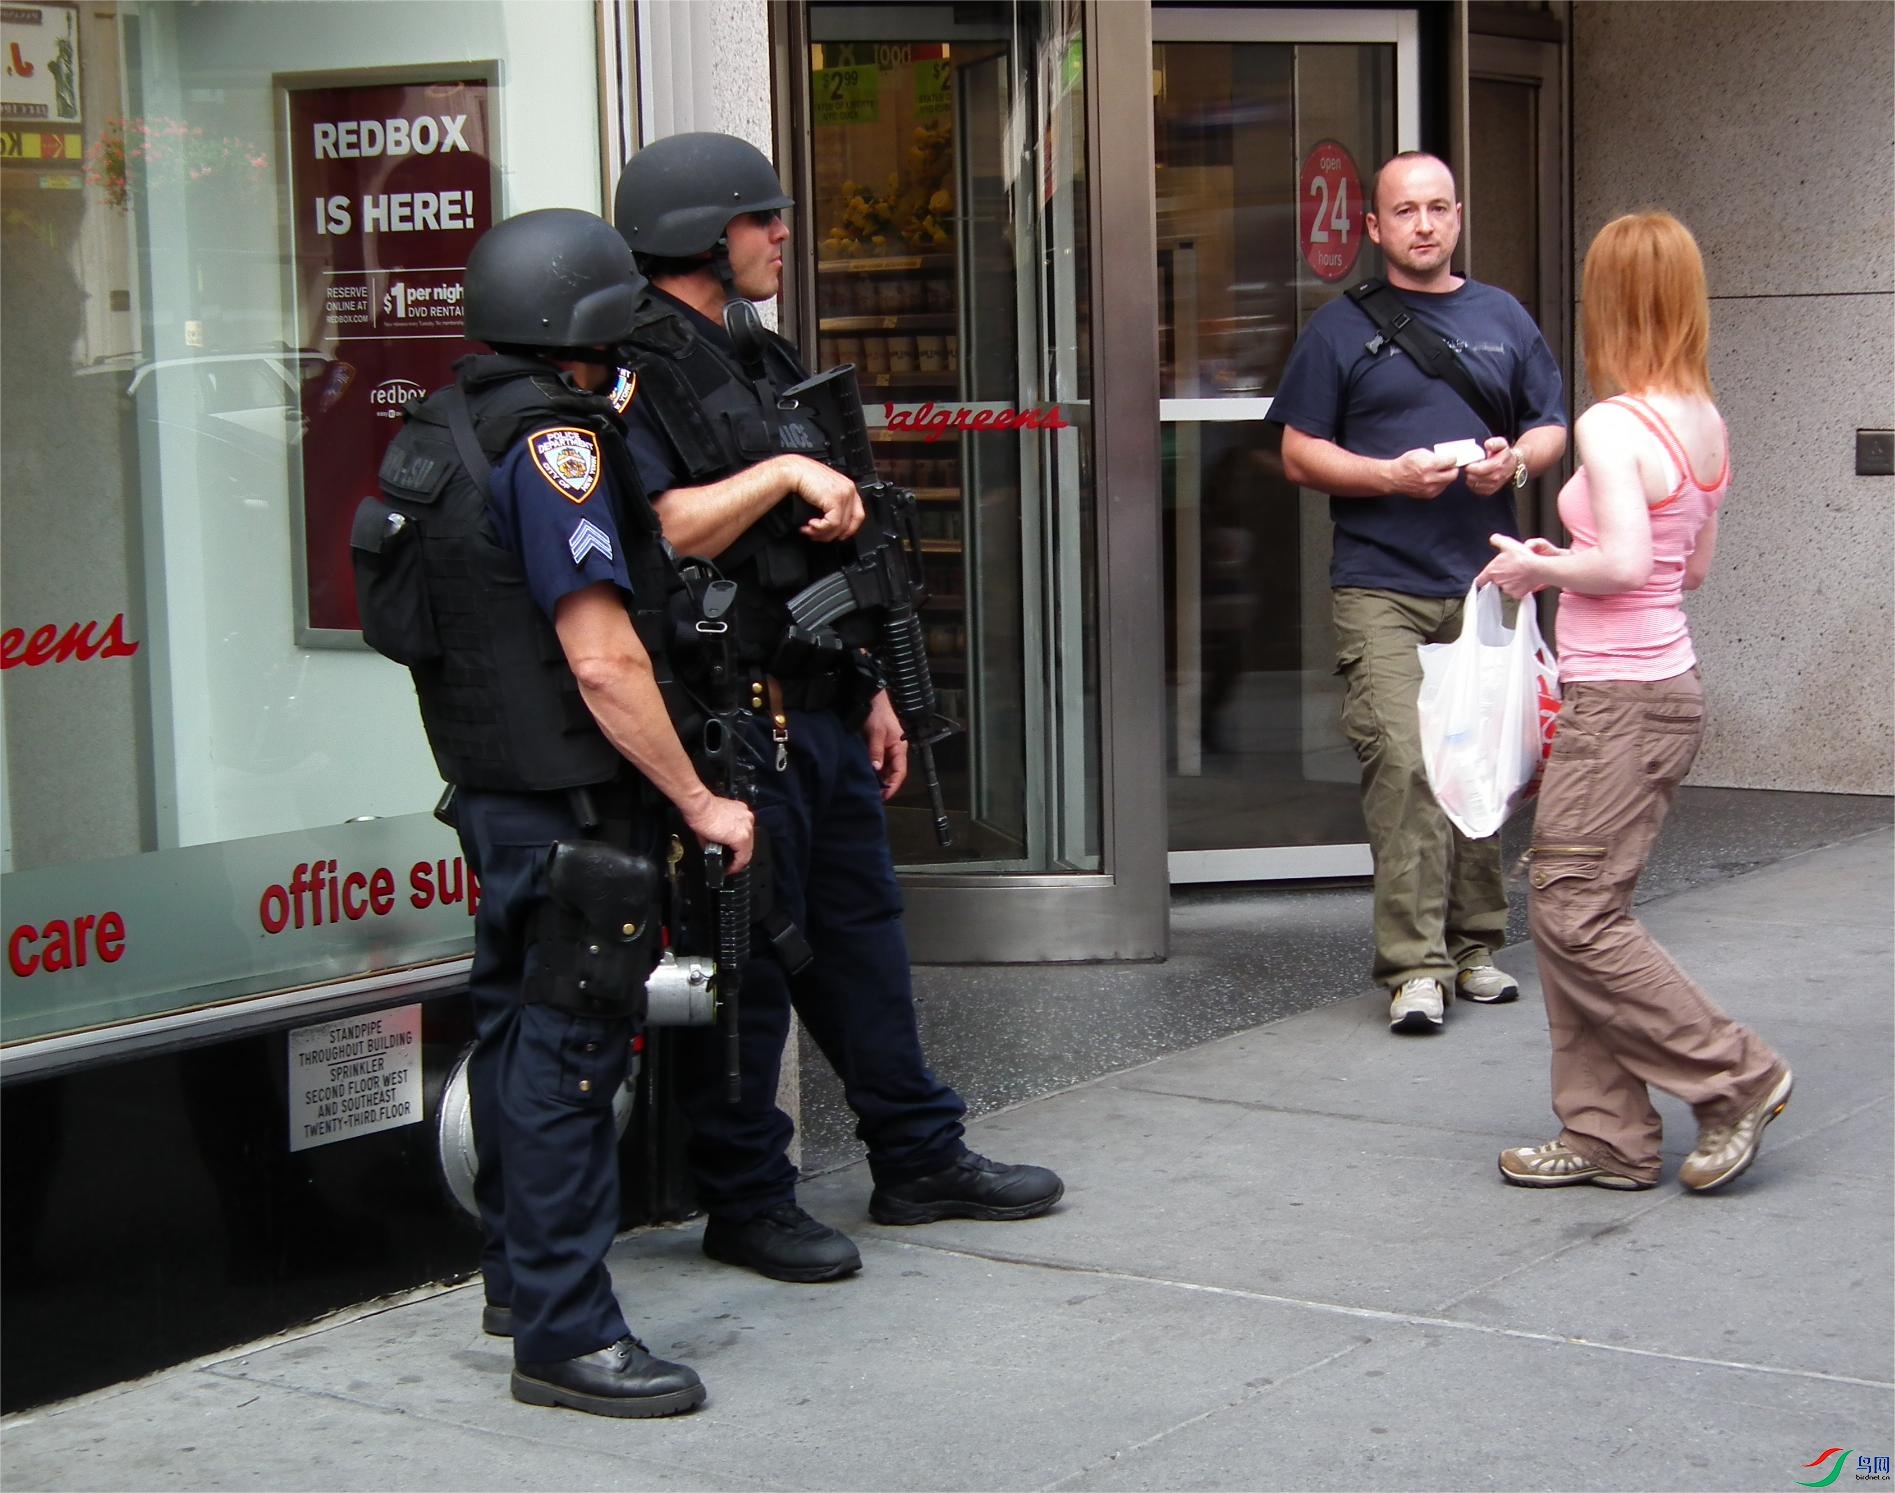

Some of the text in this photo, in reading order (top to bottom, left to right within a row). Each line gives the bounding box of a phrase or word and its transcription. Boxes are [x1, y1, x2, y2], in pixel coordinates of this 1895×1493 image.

[313, 115, 471, 160] REDBOX
[1320, 157, 1342, 173] open
[315, 190, 474, 235] IS HERE!
[1310, 175, 1350, 244] 24
[1318, 251, 1342, 266] hours
[326, 286, 368, 298] RESERVE
[326, 301, 368, 312] ONLINE AT
[383, 282, 464, 318] $1 per nigh
[326, 314, 369, 324] REDBOX.COM
[408, 307, 428, 318] DVD
[546, 431, 580, 443] POLICE
[884, 401, 1069, 442] algreens
[537, 437, 594, 455] DEPARTMENT
[260, 859, 396, 935] office
[8, 910, 126, 978] care
[330, 1020, 383, 1044] STANDPIPE
[299, 1031, 412, 1067] THROUGHOUT BUILDING
[330, 1057, 384, 1082] SPRINKLER
[305, 1069, 409, 1105] SECOND FLOOR WEST
[318, 1088, 397, 1119] AND SOUTHEAST
[304, 1101, 411, 1138] TWENTY-THIRD FLOOR
